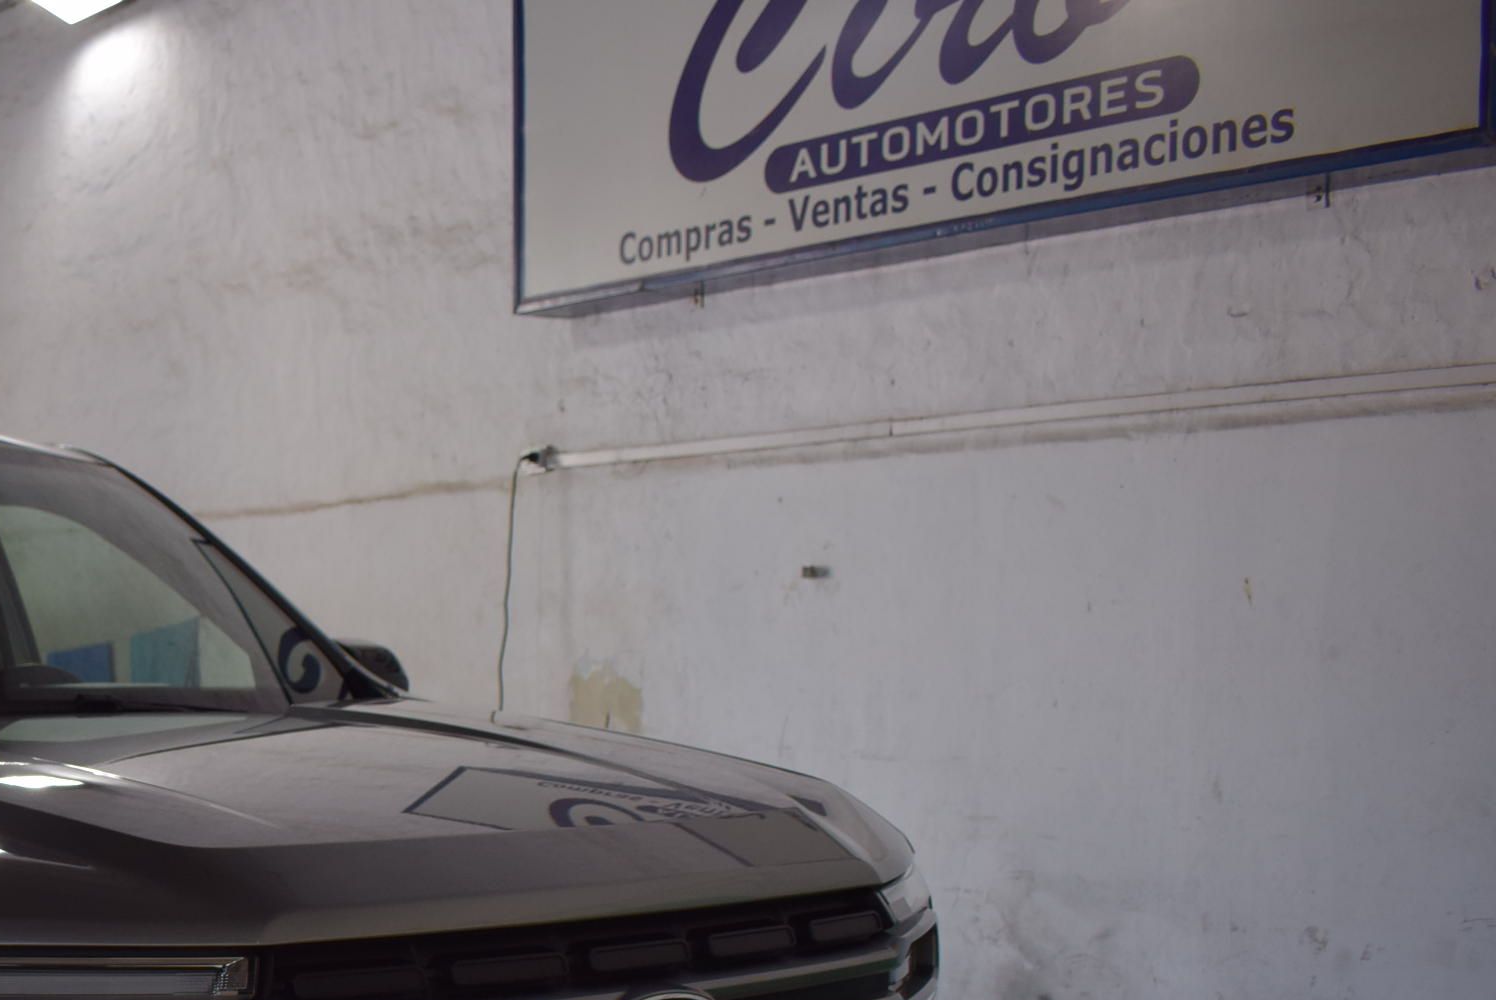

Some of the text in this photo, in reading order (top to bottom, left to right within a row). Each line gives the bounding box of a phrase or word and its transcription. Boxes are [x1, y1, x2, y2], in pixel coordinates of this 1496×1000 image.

[619, 214, 752, 264] Compras
[789, 183, 909, 232] Ventas
[951, 107, 1295, 202] Consignaciones
[789, 69, 1166, 182] AUTOMOTORES
